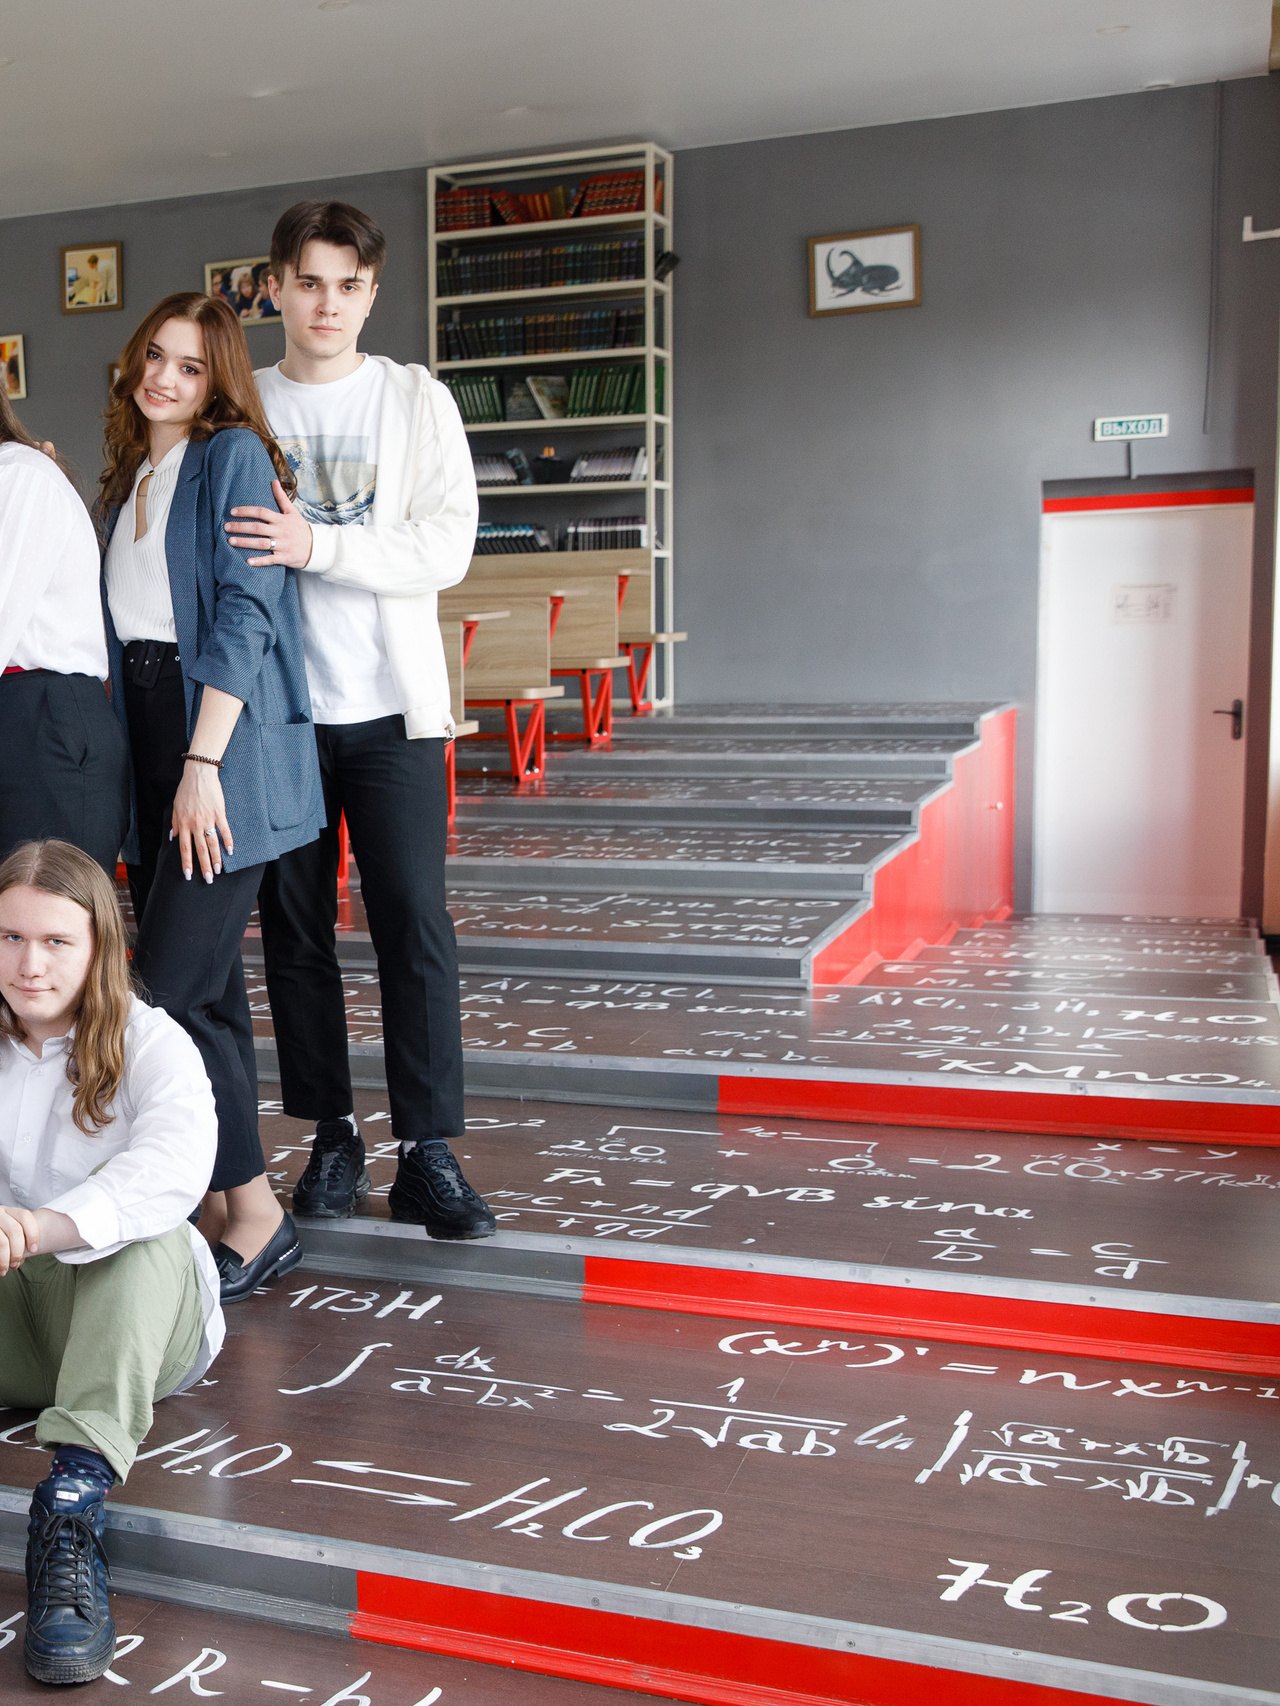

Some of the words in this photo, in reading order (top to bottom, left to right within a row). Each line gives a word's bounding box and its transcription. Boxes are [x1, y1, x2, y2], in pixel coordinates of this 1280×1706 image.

[1102, 418, 1162, 436] ВЫХОД
[938, 1057, 1272, 1088] KMnO4
[936, 1557, 1228, 1633] H2O
